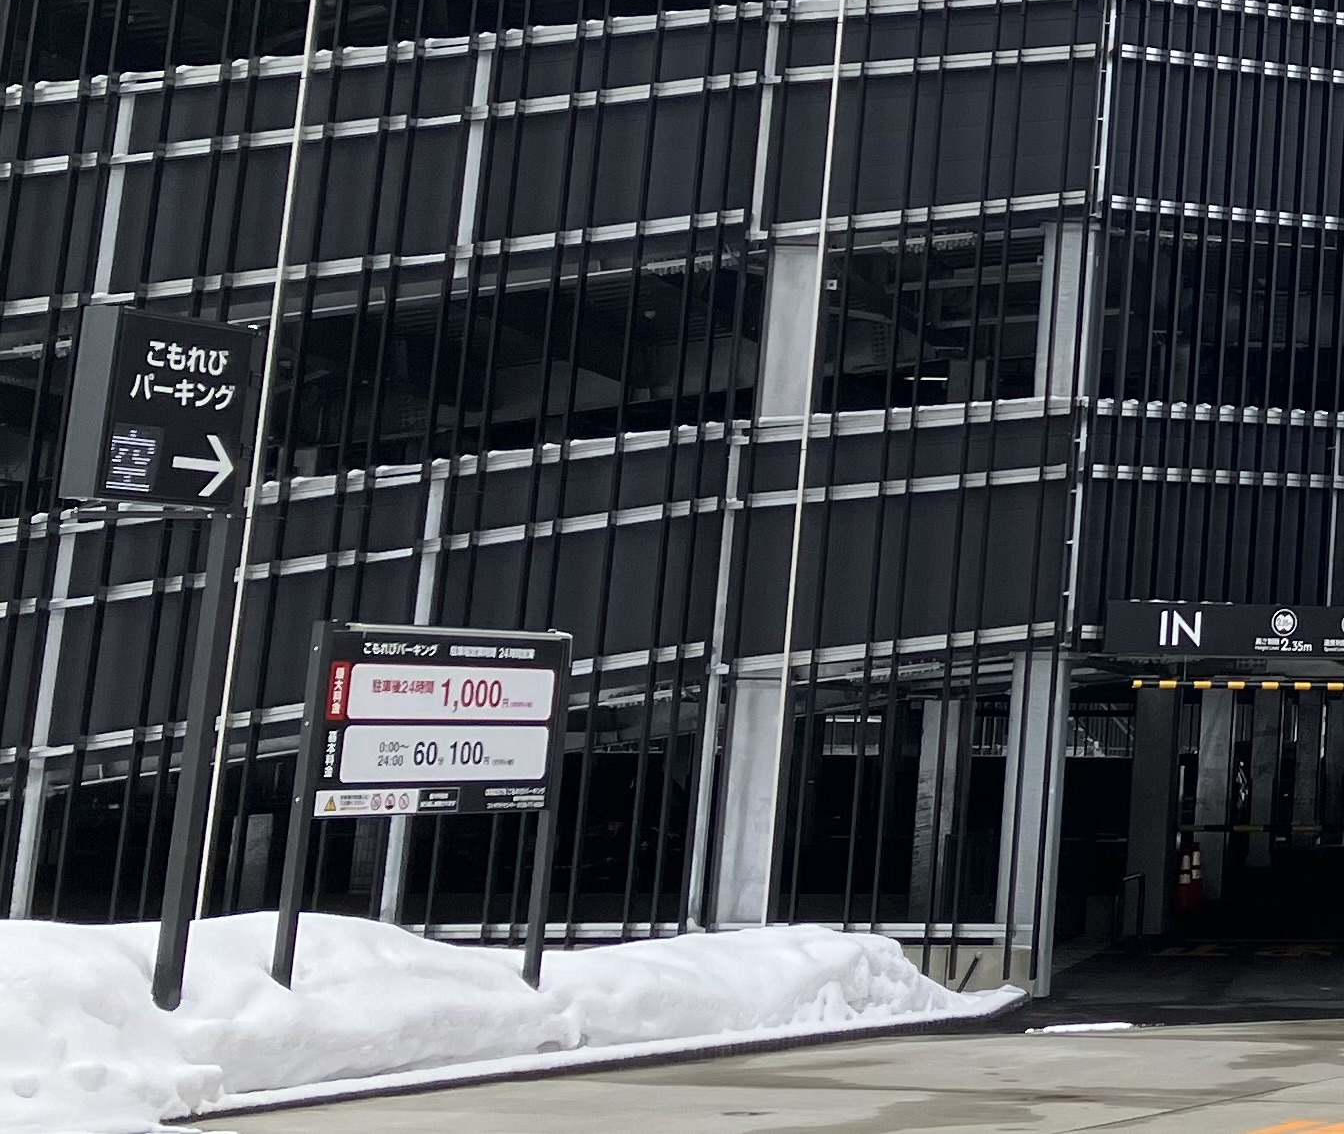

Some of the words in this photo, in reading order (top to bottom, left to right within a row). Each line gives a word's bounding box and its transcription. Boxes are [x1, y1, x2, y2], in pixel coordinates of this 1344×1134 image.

[147, 340, 229, 375] こもれび
[130, 373, 236, 410] パーキング
[1159, 611, 1202, 647] IN
[363, 642, 439, 656] こもれびパーキング
[1280, 637, 1313, 652] 2.35m
[377, 754, 404, 767] 24:00
